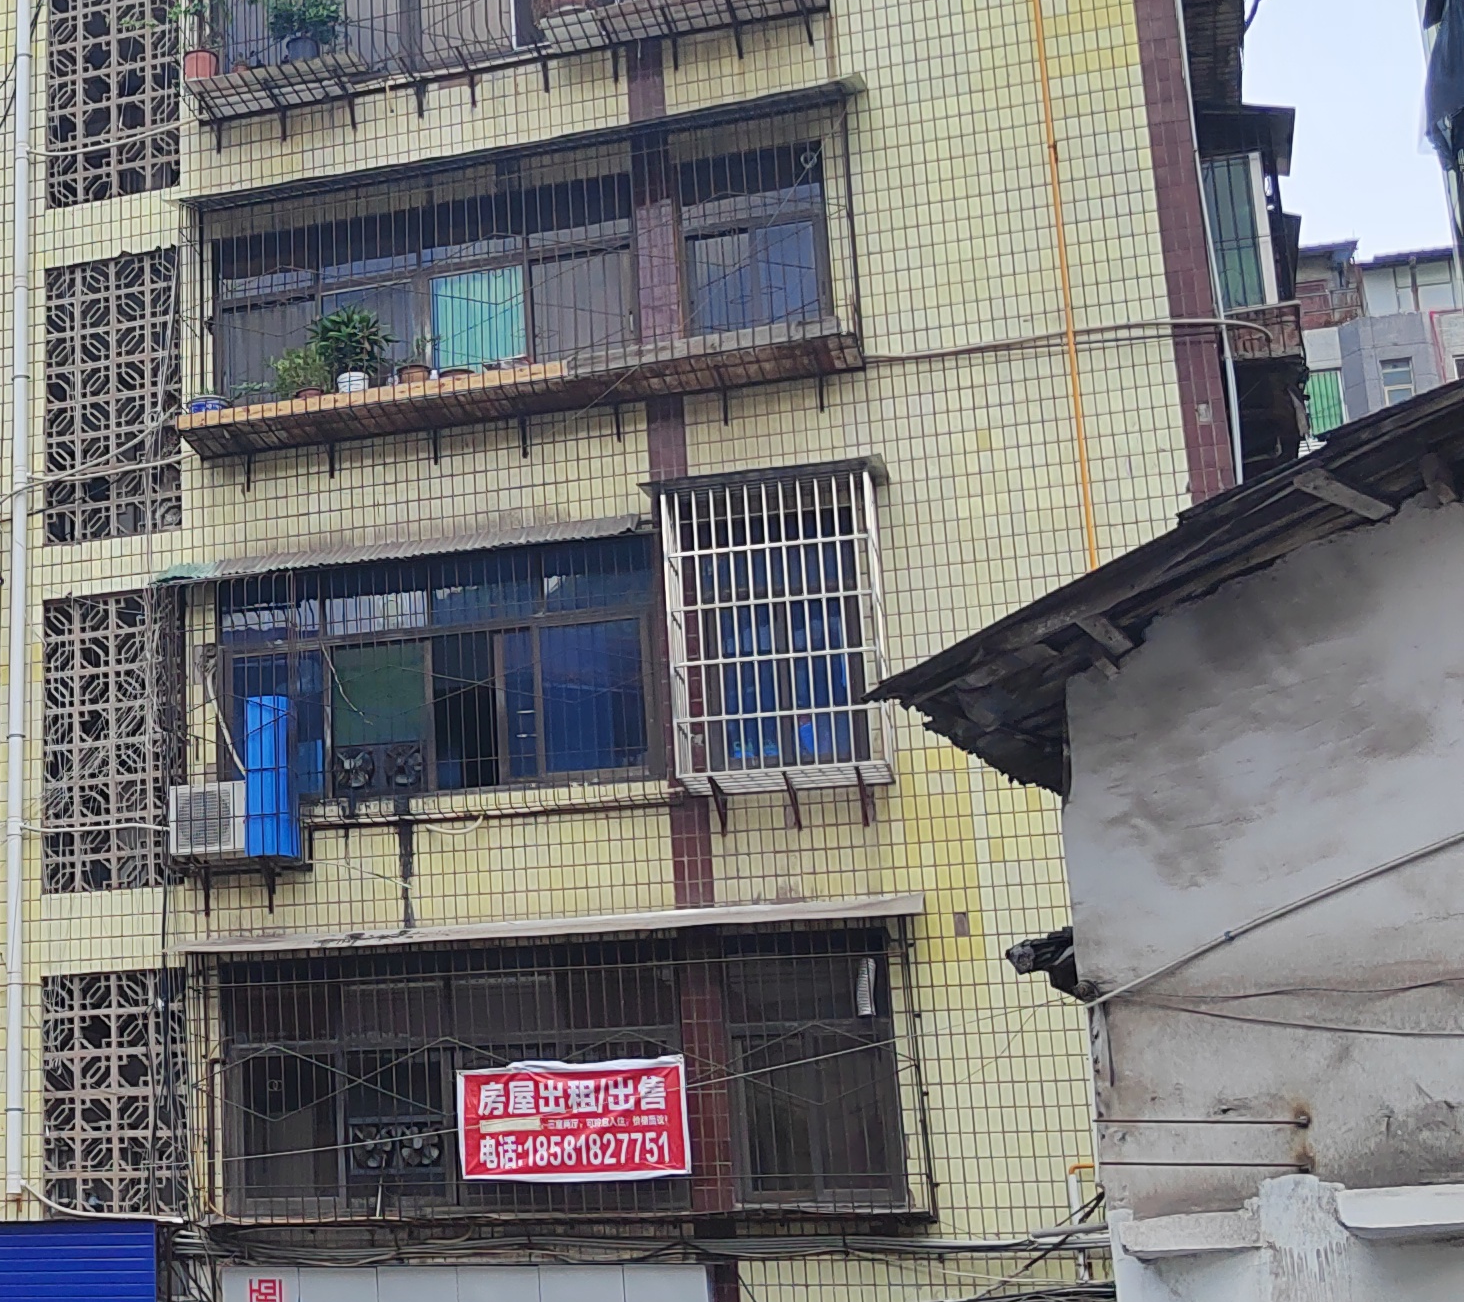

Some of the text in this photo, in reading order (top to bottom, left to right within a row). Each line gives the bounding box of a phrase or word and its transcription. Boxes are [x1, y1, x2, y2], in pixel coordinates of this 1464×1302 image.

[478, 1076, 667, 1116] 房屋出租/出售
[479, 1131, 670, 1170] 电话:18581827751
